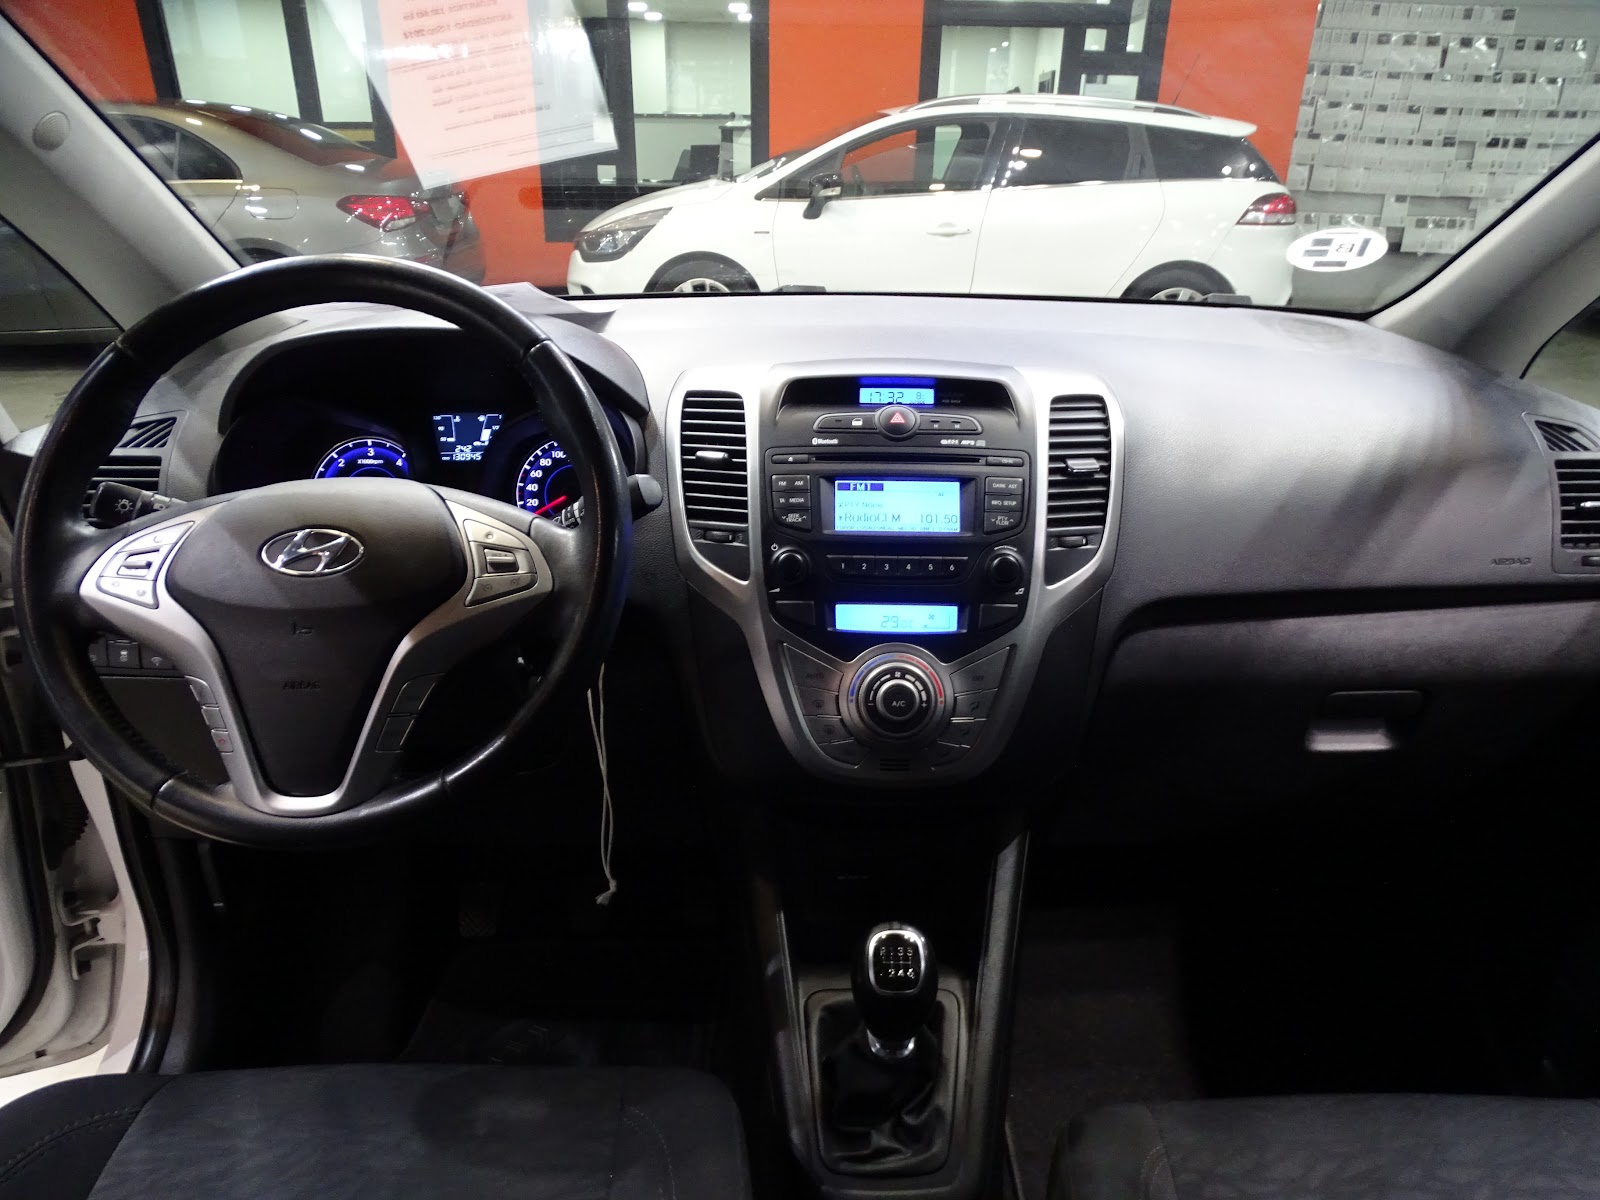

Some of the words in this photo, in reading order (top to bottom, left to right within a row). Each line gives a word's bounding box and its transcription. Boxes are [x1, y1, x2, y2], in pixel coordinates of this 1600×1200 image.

[366, 447, 375, 457] 3
[454, 444, 473, 453] 242
[452, 453, 482, 461] 130945
[337, 458, 345, 468] 2
[395, 458, 403, 468] 4
[539, 458, 552, 467] 80
[529, 469, 543, 479] 60
[525, 482, 539, 492] 40
[849, 482, 872, 491] FM1
[526, 497, 539, 507] 20
[919, 513, 958, 525] 101.50
[883, 563, 890, 571] 3
[905, 563, 912, 571] 4
[928, 563, 934, 571] 5
[891, 700, 907, 708] A/C
[897, 946, 905, 957] 3
